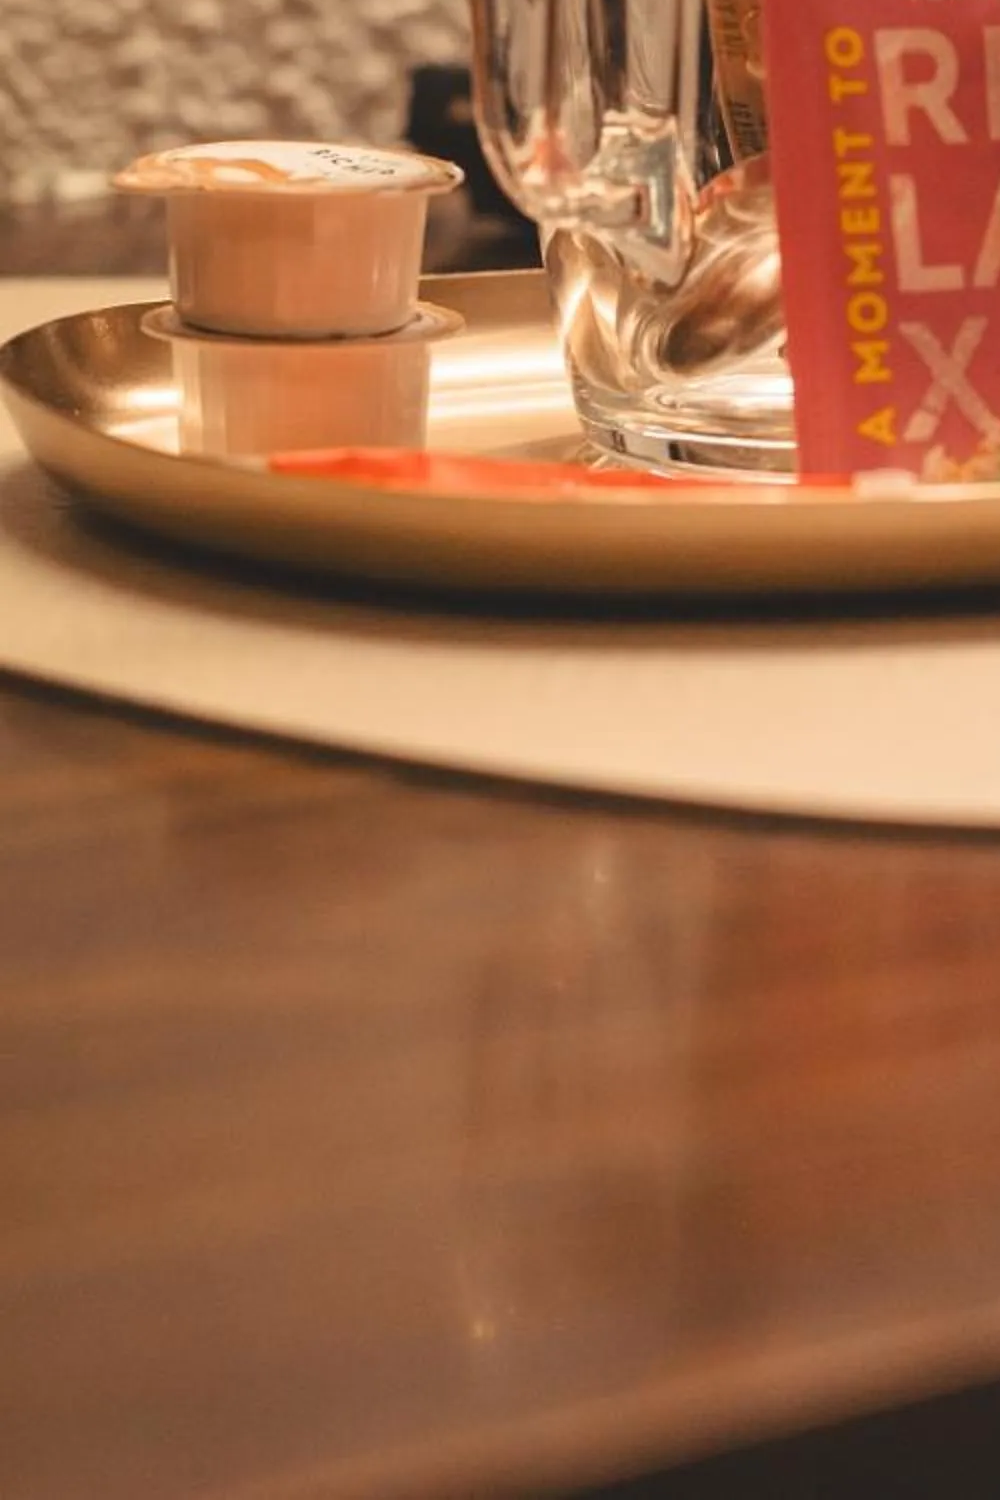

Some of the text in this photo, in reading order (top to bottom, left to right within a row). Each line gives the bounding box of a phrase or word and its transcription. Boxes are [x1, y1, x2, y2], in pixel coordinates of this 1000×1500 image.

[825, 27, 896, 445] A MOMENT TO
